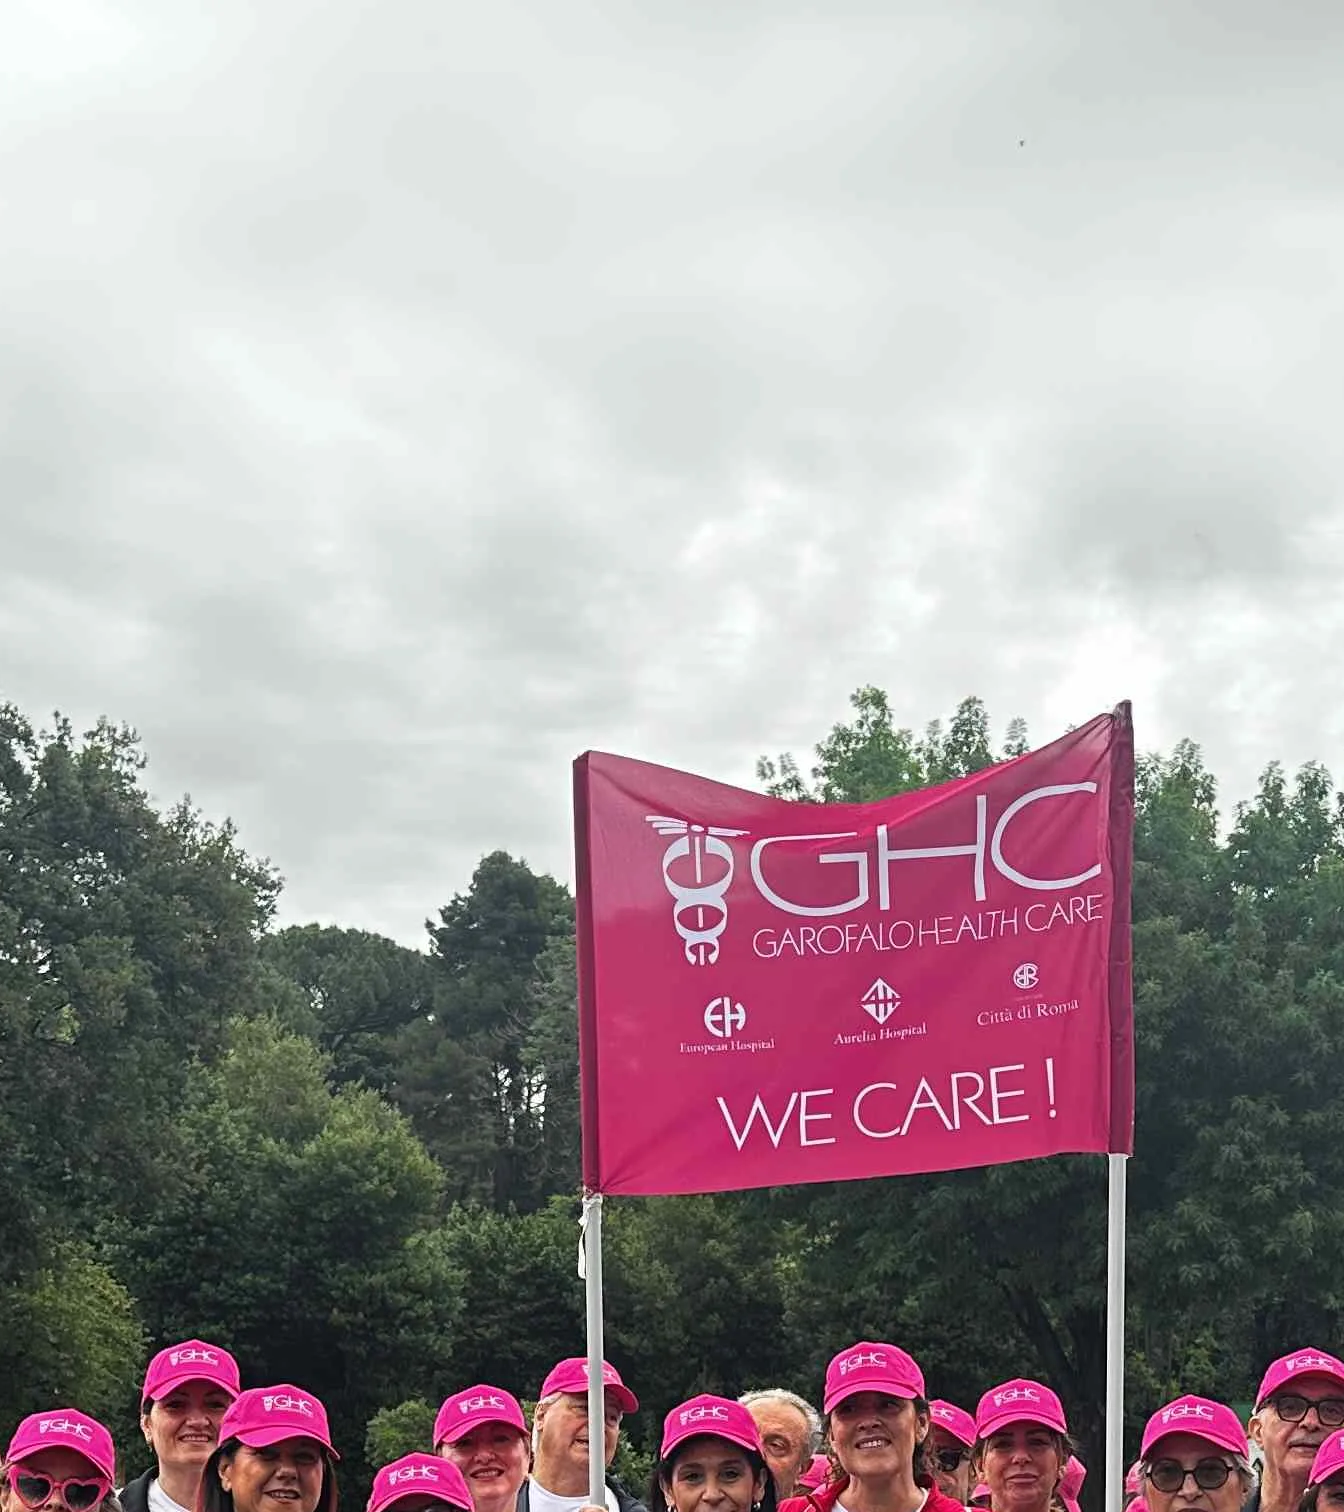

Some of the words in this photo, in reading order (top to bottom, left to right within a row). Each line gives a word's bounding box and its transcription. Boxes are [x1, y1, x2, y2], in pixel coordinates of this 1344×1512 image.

[750, 781, 1103, 917] GHC
[752, 920, 915, 959] GAROFALO
[919, 906, 1019, 946] HEALTH
[1025, 893, 1105, 933] CARE
[976, 1007, 1014, 1028] Città
[1017, 1004, 1033, 1021] di
[1036, 998, 1080, 1018] Roma
[834, 1028, 878, 1046] Aurelia
[878, 1021, 928, 1042] Hospital
[679, 1041, 729, 1055] European
[730, 1038, 776, 1053] Hospital
[716, 1088, 837, 1153] WE
[852, 1063, 1030, 1139] CARE
[1044, 1057, 1059, 1120] !
[178, 1350, 219, 1363] GHC
[846, 1352, 888, 1367] GHC
[468, 1396, 506, 1409] GHC
[1003, 1388, 1040, 1400] GHC
[273, 1396, 313, 1413] GHC
[689, 1406, 728, 1419] GHC
[1171, 1404, 1214, 1418] GHC
[51, 1419, 93, 1437] GHC
[397, 1465, 439, 1480] GHC
